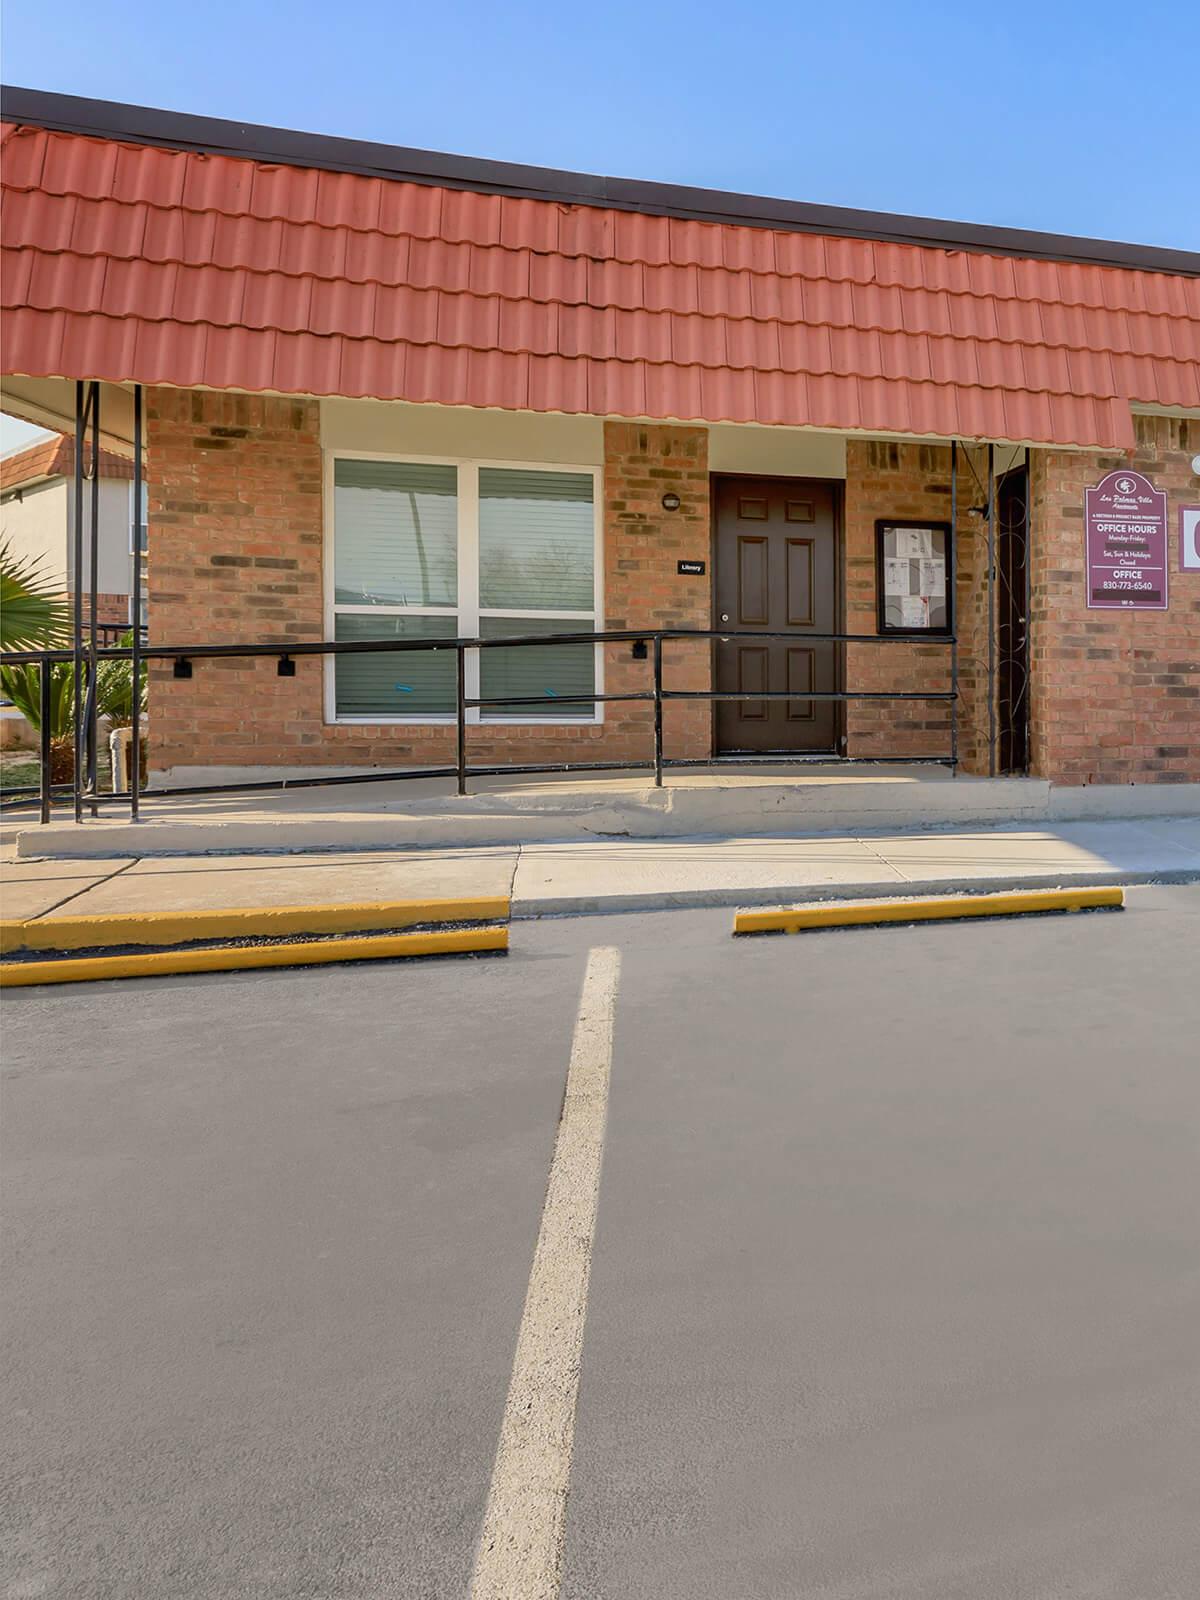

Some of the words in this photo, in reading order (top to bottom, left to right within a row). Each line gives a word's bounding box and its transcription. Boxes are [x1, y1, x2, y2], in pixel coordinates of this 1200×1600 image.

[1096, 524, 1127, 533] OFFICE
[1127, 525, 1157, 534] HOURS
[1113, 570, 1143, 579] OFFICE
[1103, 581, 1152, 590] 830-773-6540
